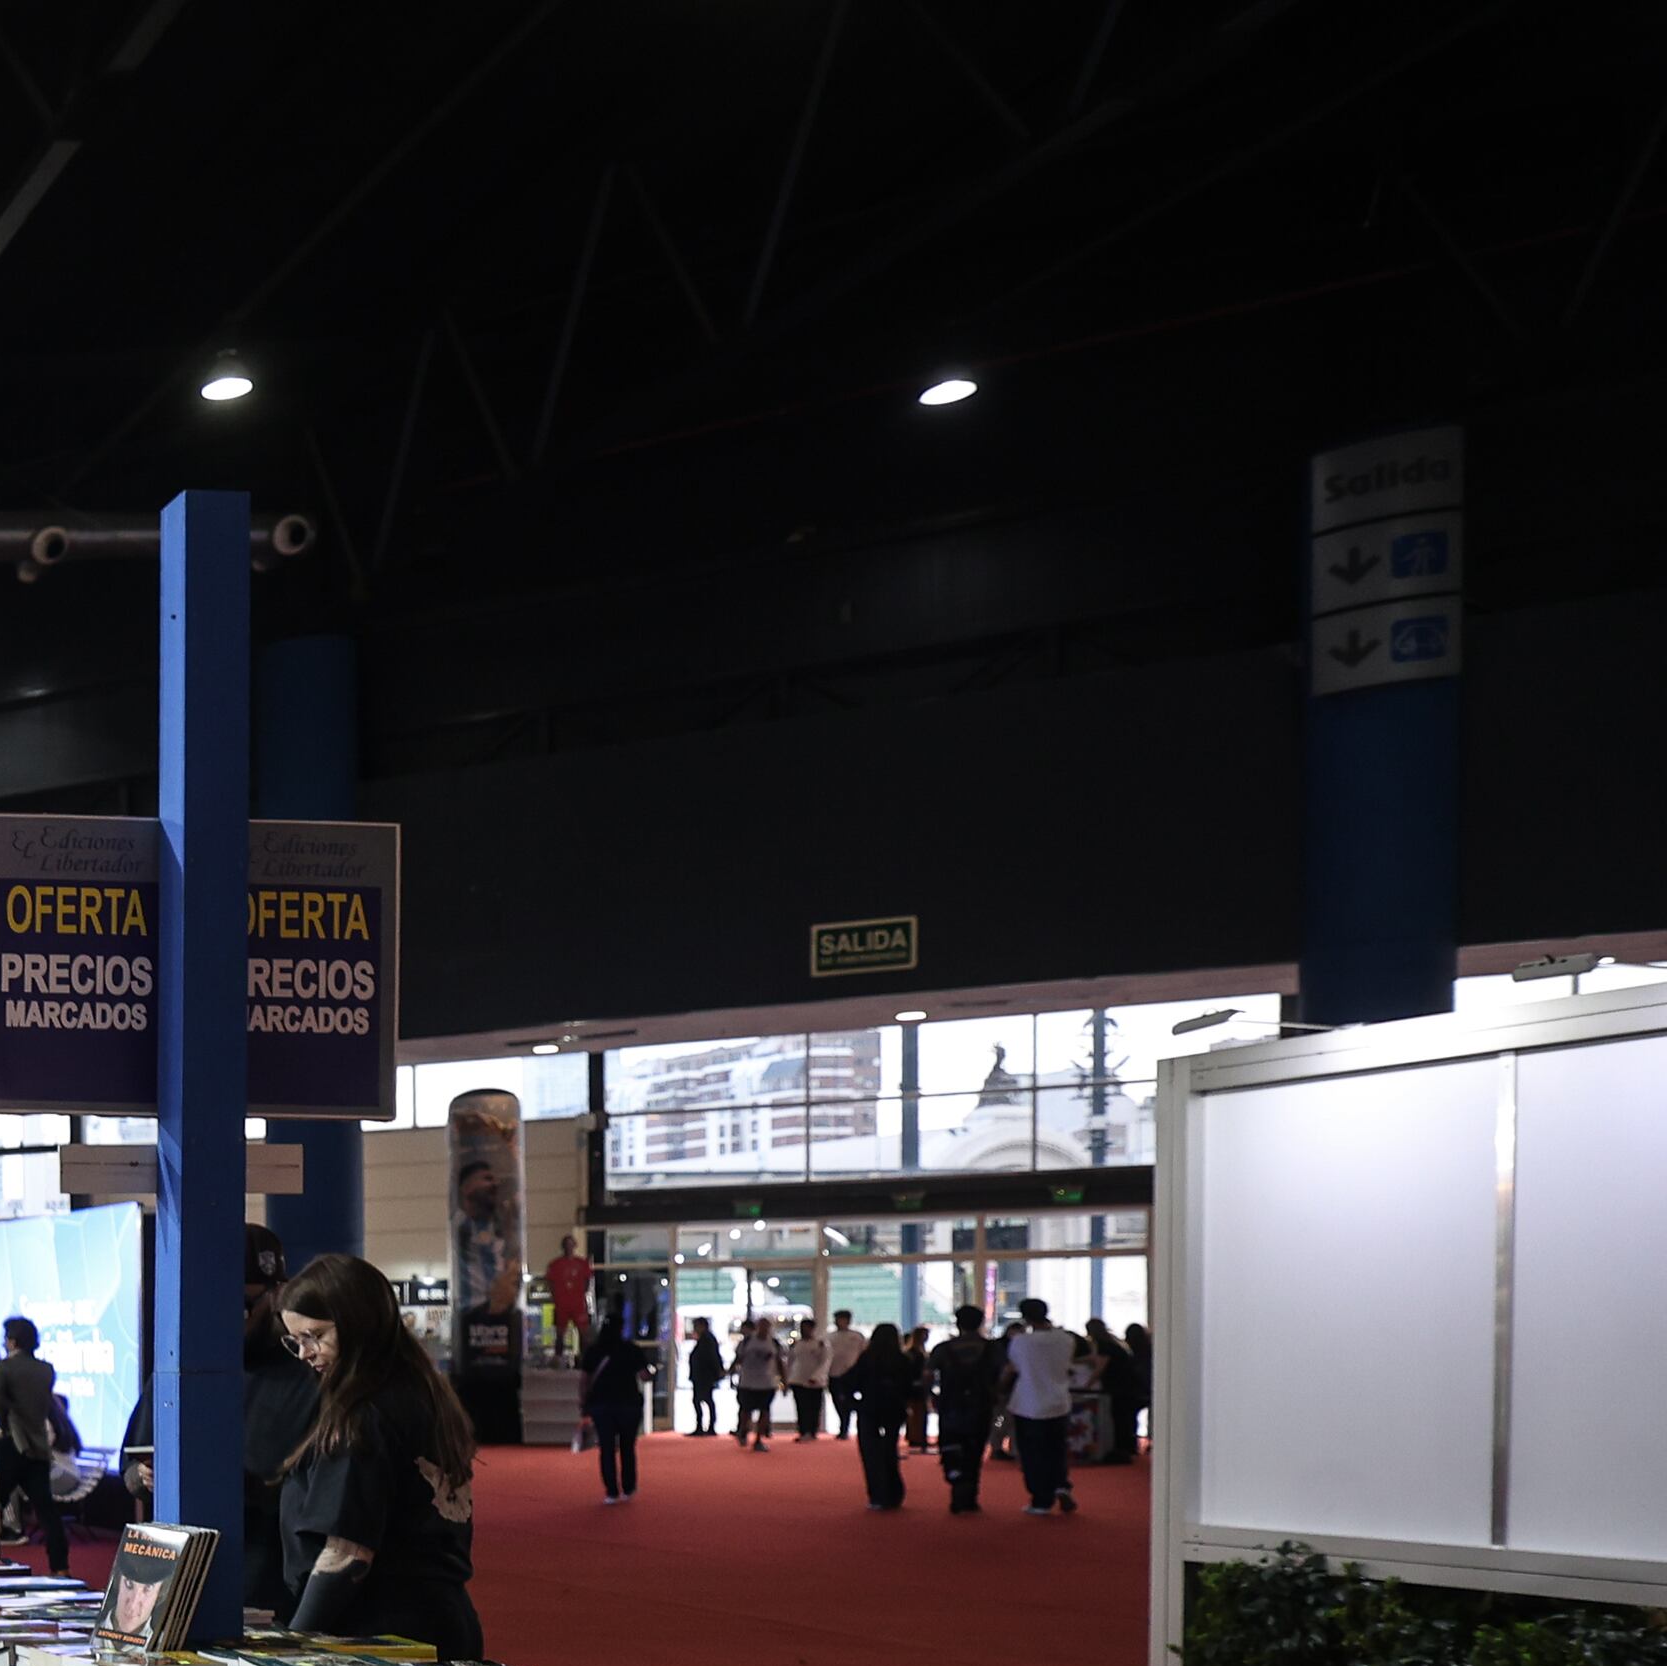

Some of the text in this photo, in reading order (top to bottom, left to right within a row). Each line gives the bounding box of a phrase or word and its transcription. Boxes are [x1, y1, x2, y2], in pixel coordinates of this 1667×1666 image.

[1324, 456, 1450, 504] Salida
[39, 824, 135, 854] Ediciones
[262, 831, 358, 859] Ediciones
[39, 854, 144, 877] Libertador
[262, 857, 367, 881] Libertador
[5, 883, 148, 937] OFERTA
[820, 928, 907, 956] SALIDA
[0, 952, 153, 998] PRECIOS
[4, 999, 148, 1032] MARCADOS
[124, 1543, 176, 1560] MECÁNICA
